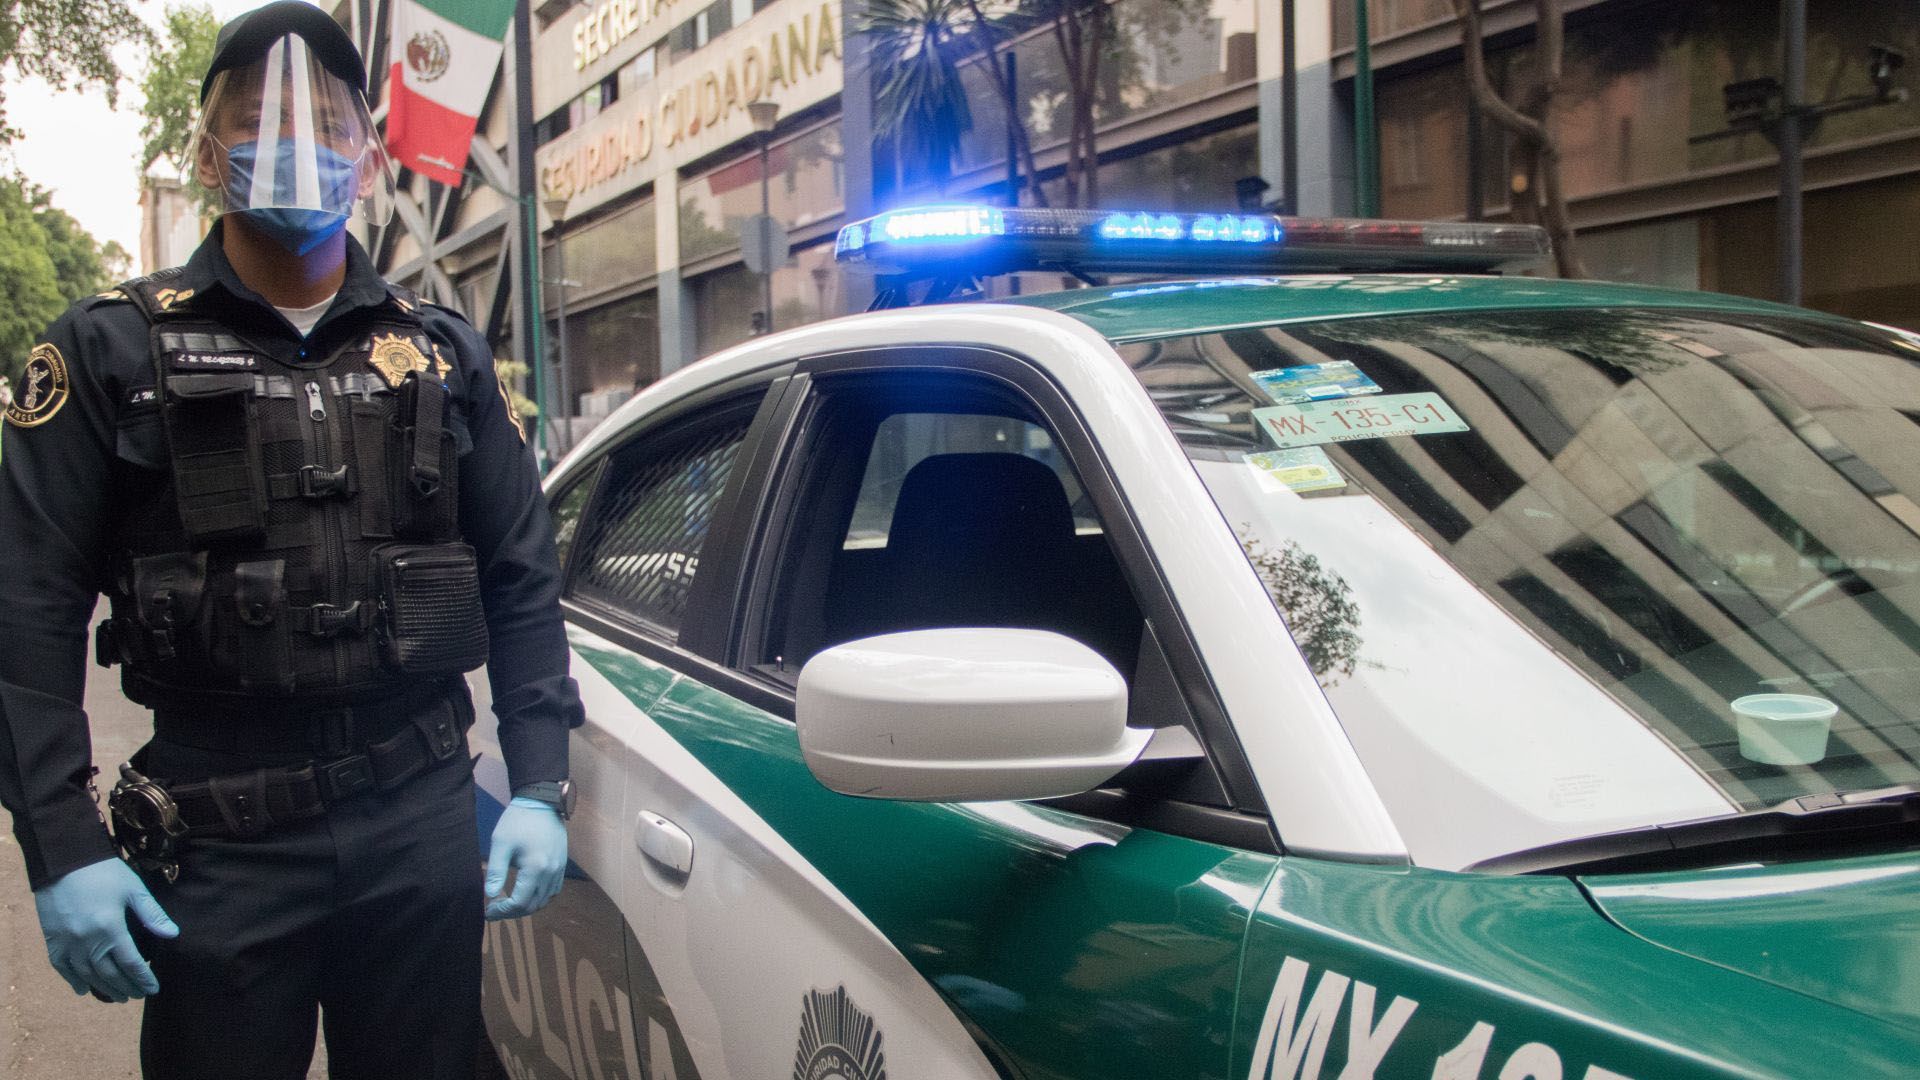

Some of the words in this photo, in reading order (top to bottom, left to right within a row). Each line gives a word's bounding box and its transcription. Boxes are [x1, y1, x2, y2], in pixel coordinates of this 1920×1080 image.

[574, 0, 682, 71] SECRE
[660, 2, 842, 148] CIUDADANA
[8, 408, 39, 422] ANGEL
[1330, 432, 1379, 442] POLICIA
